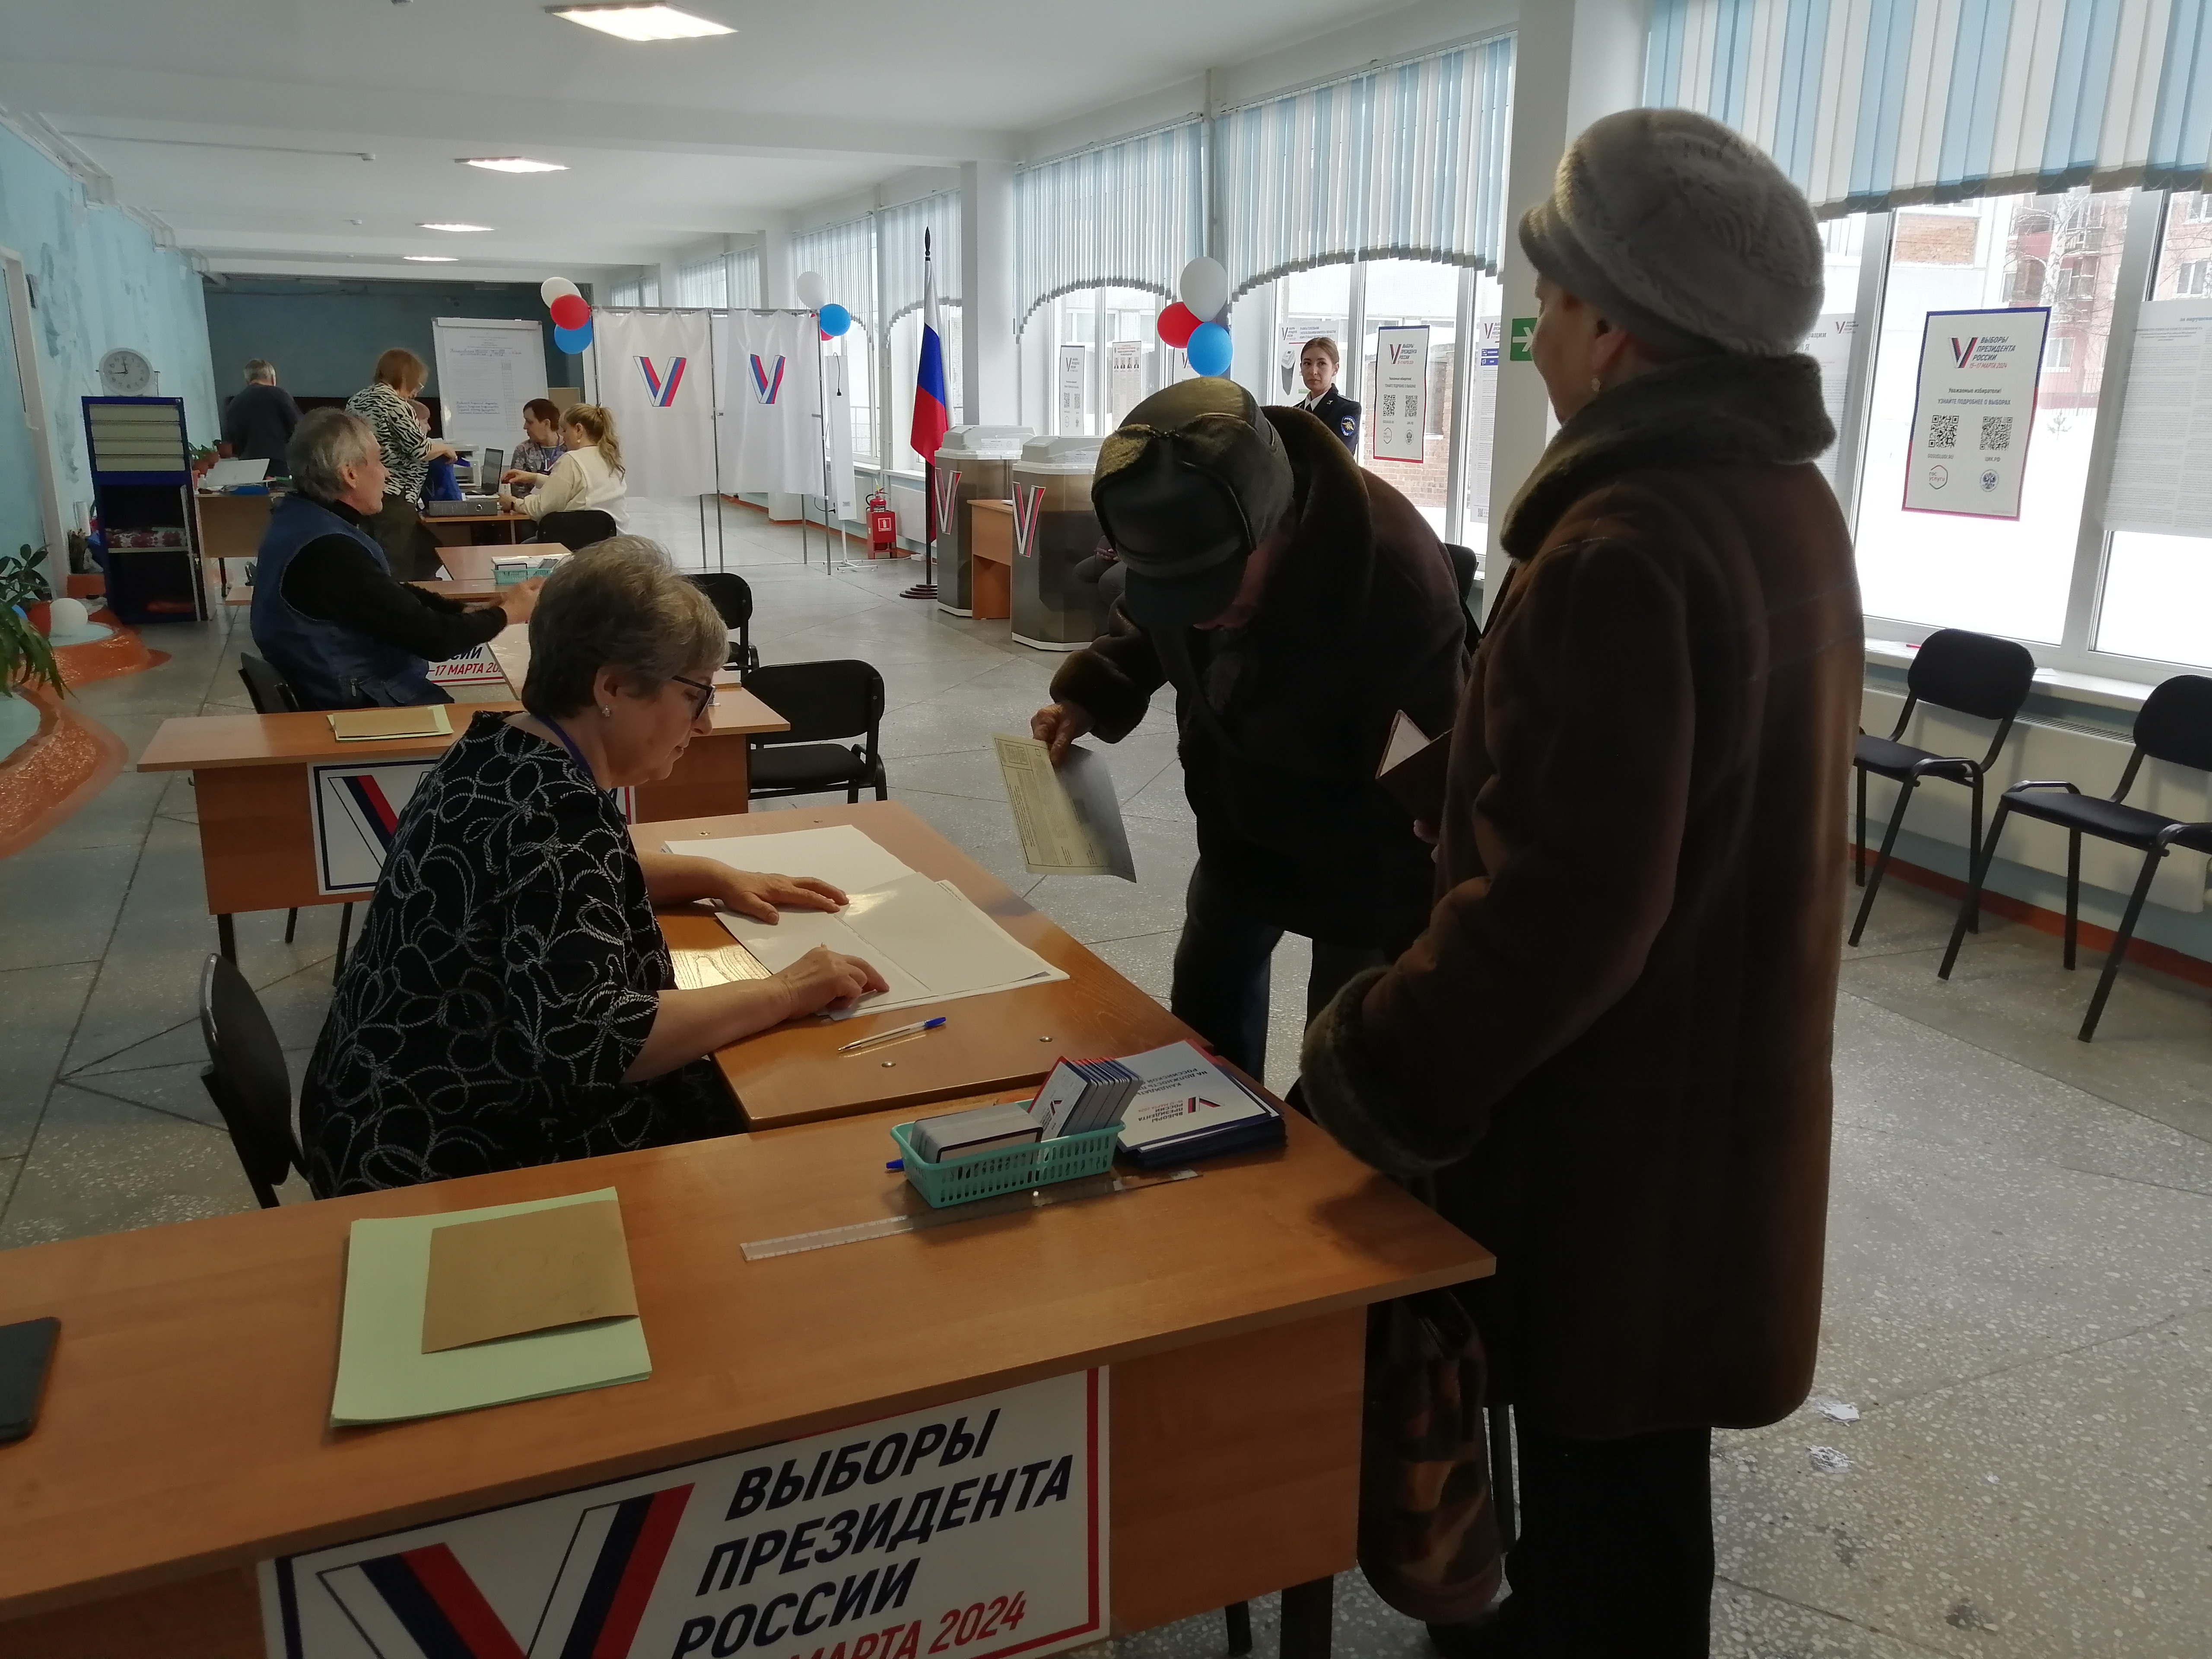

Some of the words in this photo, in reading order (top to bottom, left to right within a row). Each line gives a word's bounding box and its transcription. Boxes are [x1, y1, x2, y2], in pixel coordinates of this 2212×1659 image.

[448, 663, 483, 675] МАРТА
[486, 662, 502, 673] 20
[1147, 1068, 1198, 1083] РОССИЙСКОЙ
[1148, 1074, 1195, 1088] ДОЛЖНОСТЬ
[1138, 1108, 1183, 1122] ПРЕЗИДЕНТА
[1155, 1103, 1183, 1113] РОССИИ
[1152, 1112, 1183, 1123] ВЫБОРЫ
[725, 1408, 1001, 1521] ВЫБОРЫ
[695, 1454, 1074, 1597] ПРЕЗИДЕНТА
[671, 1557, 921, 1659] РОССИИ
[927, 1590, 1027, 1655] 2024
